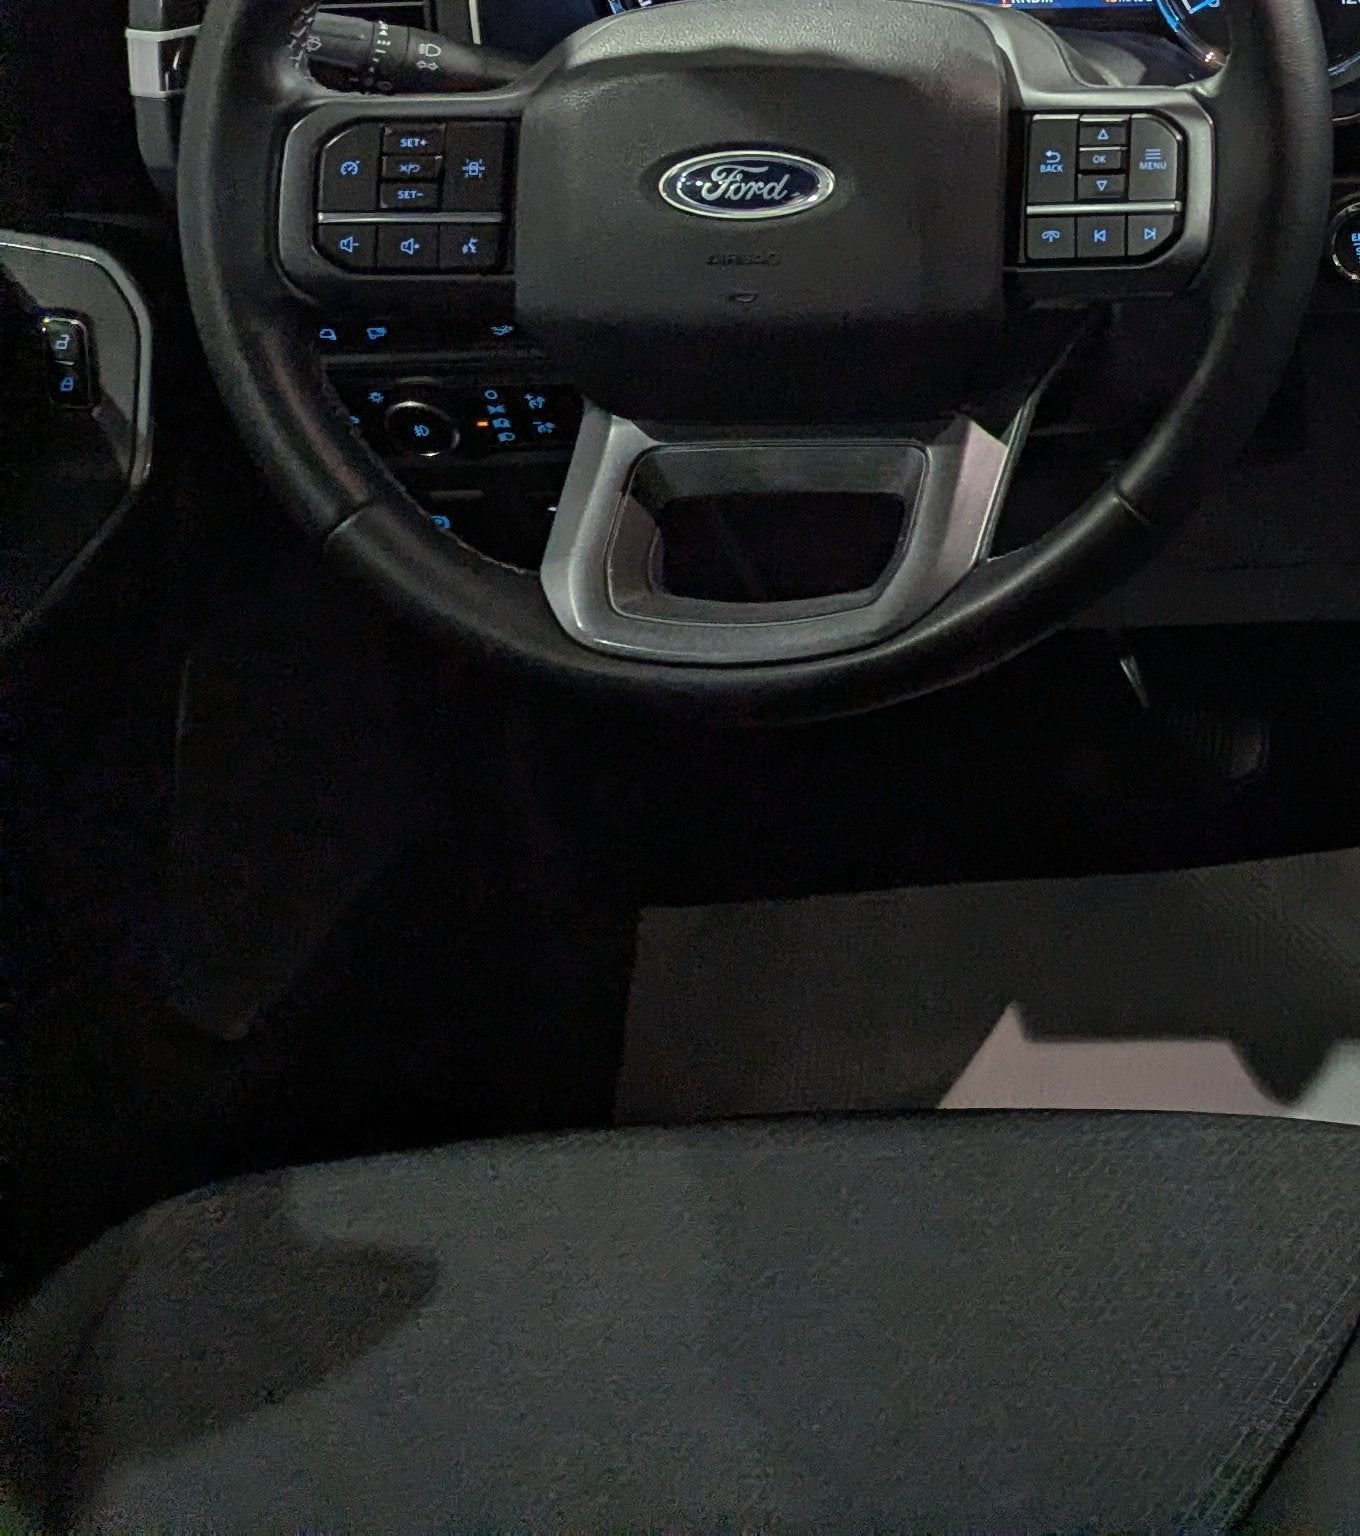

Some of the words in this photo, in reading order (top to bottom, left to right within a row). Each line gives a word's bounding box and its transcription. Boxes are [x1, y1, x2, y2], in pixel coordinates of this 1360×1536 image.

[1092, 155, 1107, 164] OK
[1040, 164, 1064, 173] BACK
[1139, 162, 1167, 170] MENU
[701, 164, 790, 201] Ford
